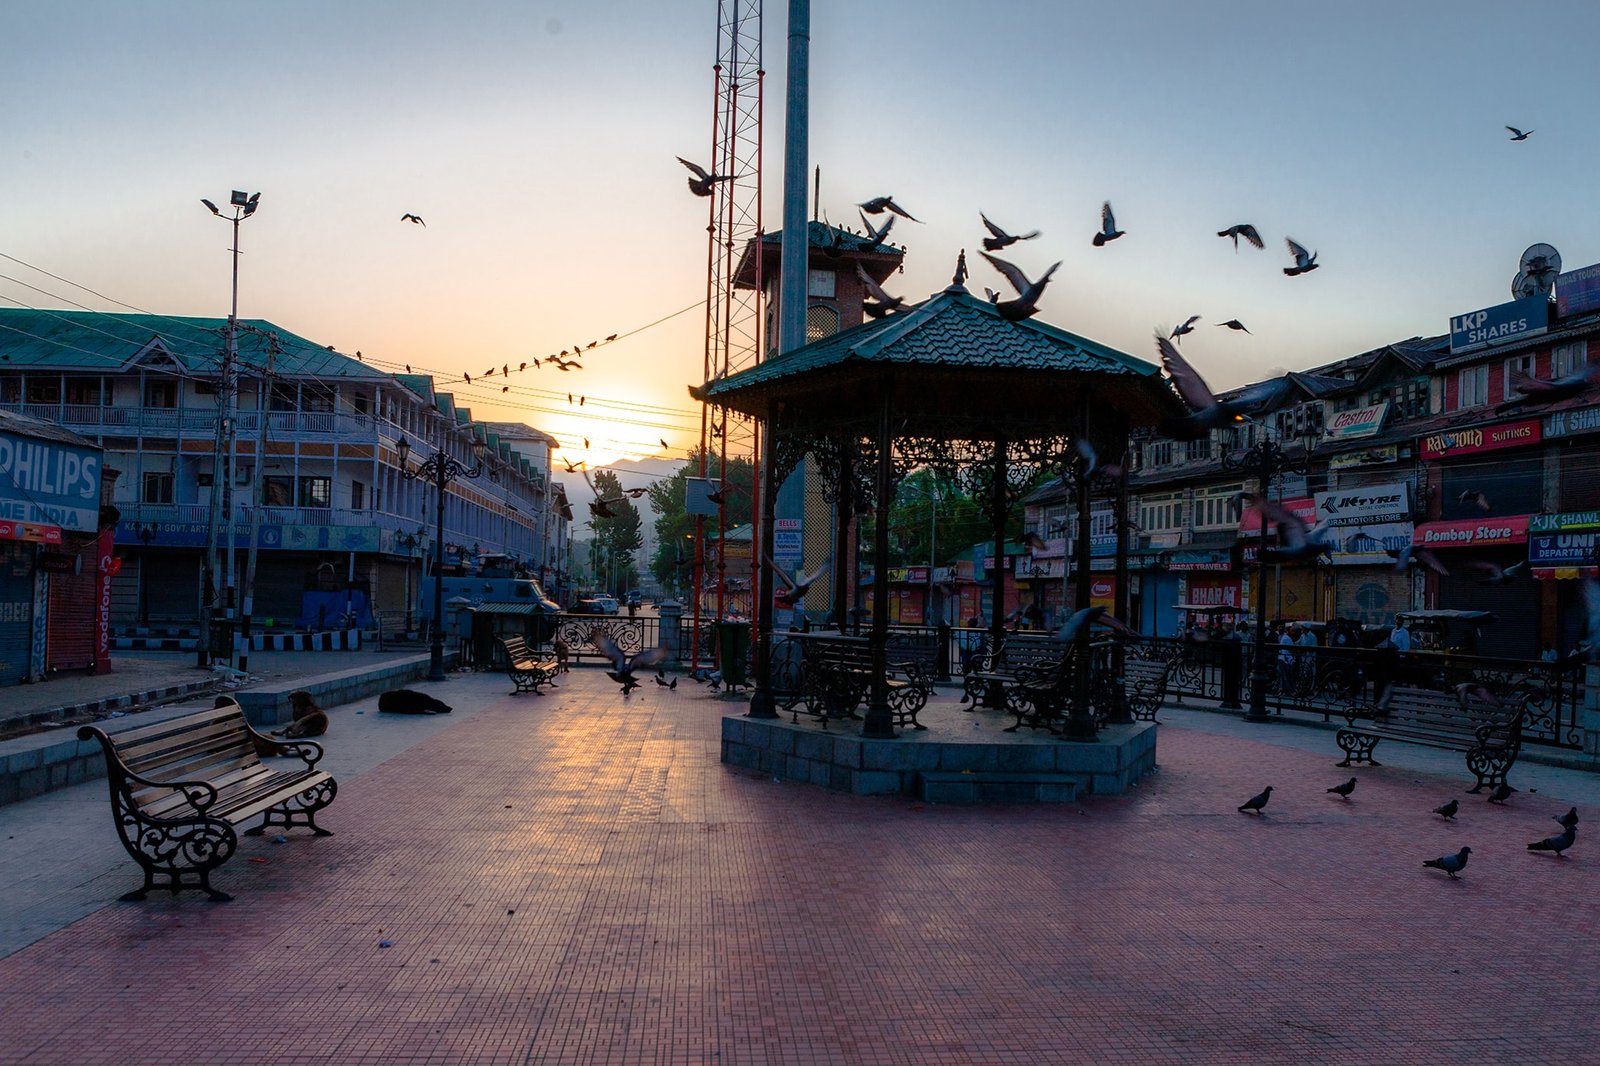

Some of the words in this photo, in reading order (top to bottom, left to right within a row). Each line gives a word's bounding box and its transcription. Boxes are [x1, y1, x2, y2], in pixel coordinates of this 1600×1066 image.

[1452, 311, 1488, 333] LKP
[1468, 318, 1527, 343] SHARES
[1334, 407, 1379, 428] Castrol
[1546, 412, 1567, 437] JK
[1492, 427, 1531, 442] SUITINGS
[0, 437, 97, 499] PHILIPS
[30, 504, 79, 527] INDIA
[1328, 517, 1347, 526] URAJ
[1348, 516, 1374, 524] MOTOR
[1375, 514, 1401, 522] STORE
[1542, 513, 1559, 530] JK
[164, 523, 188, 533] GOVT.
[1425, 529, 1474, 543] Bombay
[1476, 526, 1512, 540] Store
[1168, 563, 1196, 571] BHARAT
[1192, 586, 1237, 606] BHARAT
[100, 575, 111, 653] vodafone
